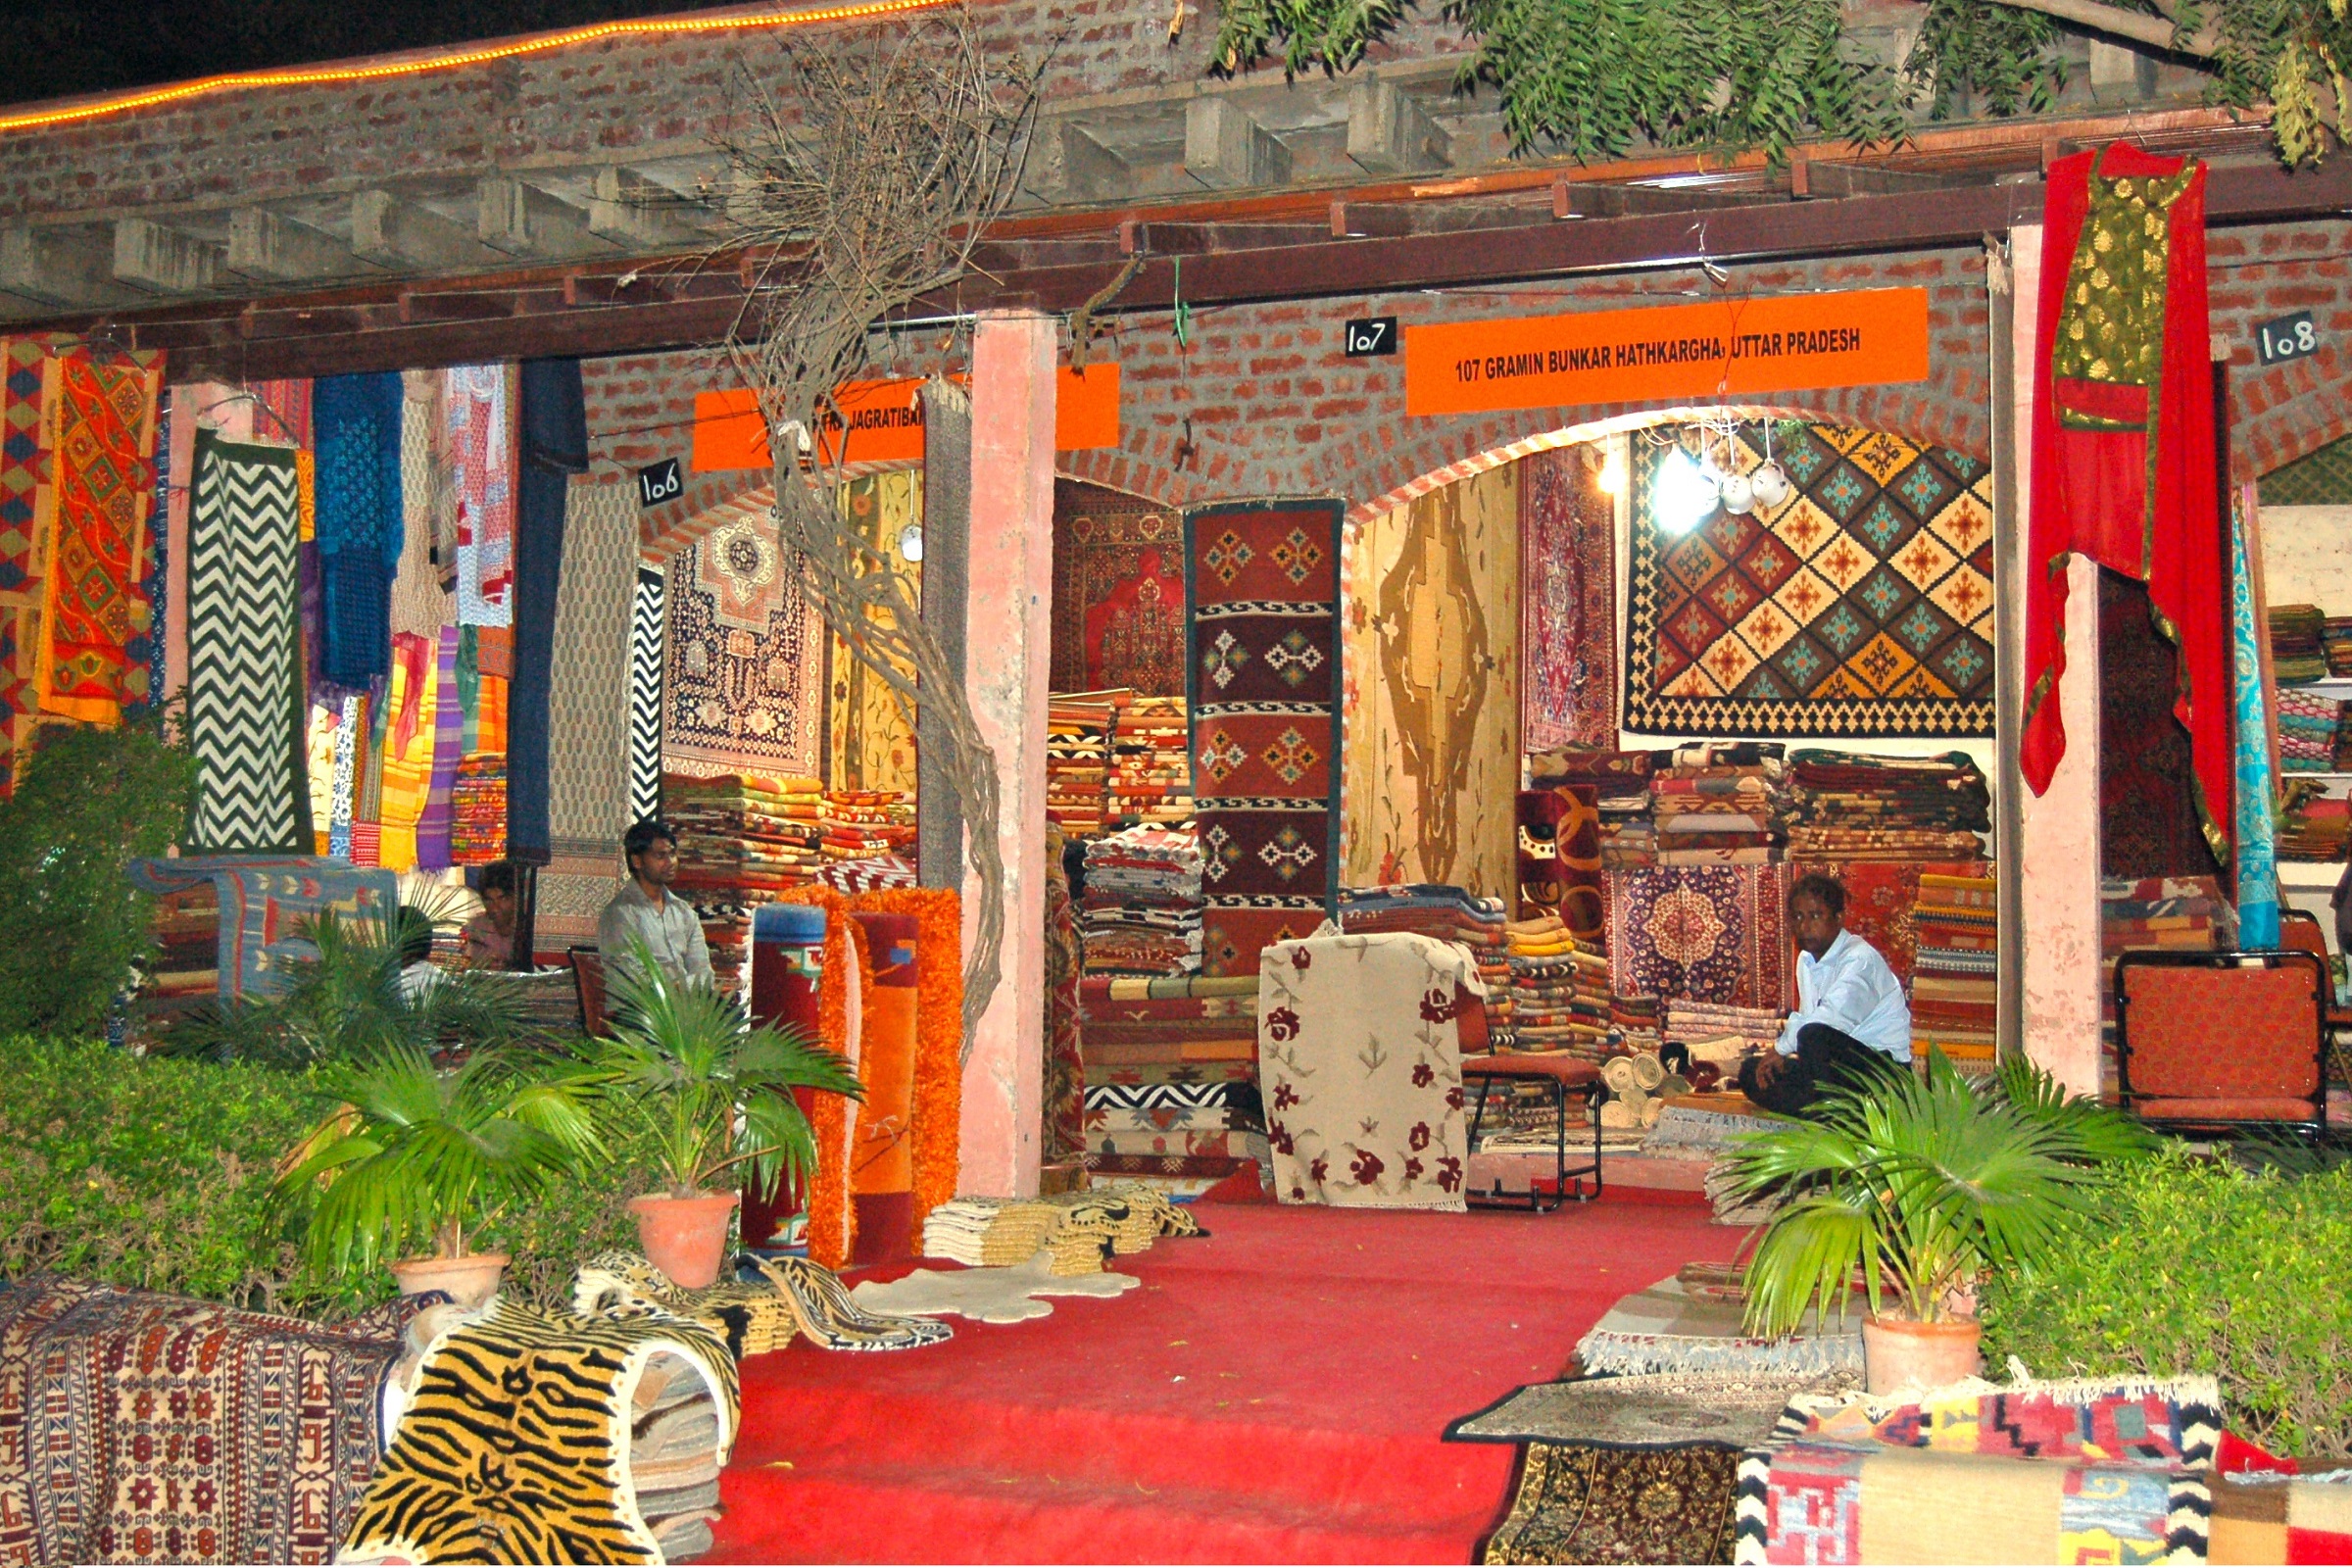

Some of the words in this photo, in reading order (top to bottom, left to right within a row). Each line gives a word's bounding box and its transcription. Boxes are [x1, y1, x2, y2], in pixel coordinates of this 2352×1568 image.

[1348, 322, 1386, 352] 107
[1456, 359, 1480, 381] 107
[1486, 352, 1544, 379] GRAMIN
[1548, 346, 1612, 372] BUNKAR
[1731, 332, 1783, 360] UTTAR
[1787, 327, 1860, 355] PRADESH
[2262, 320, 2316, 360] 108
[643, 463, 679, 502] 106
